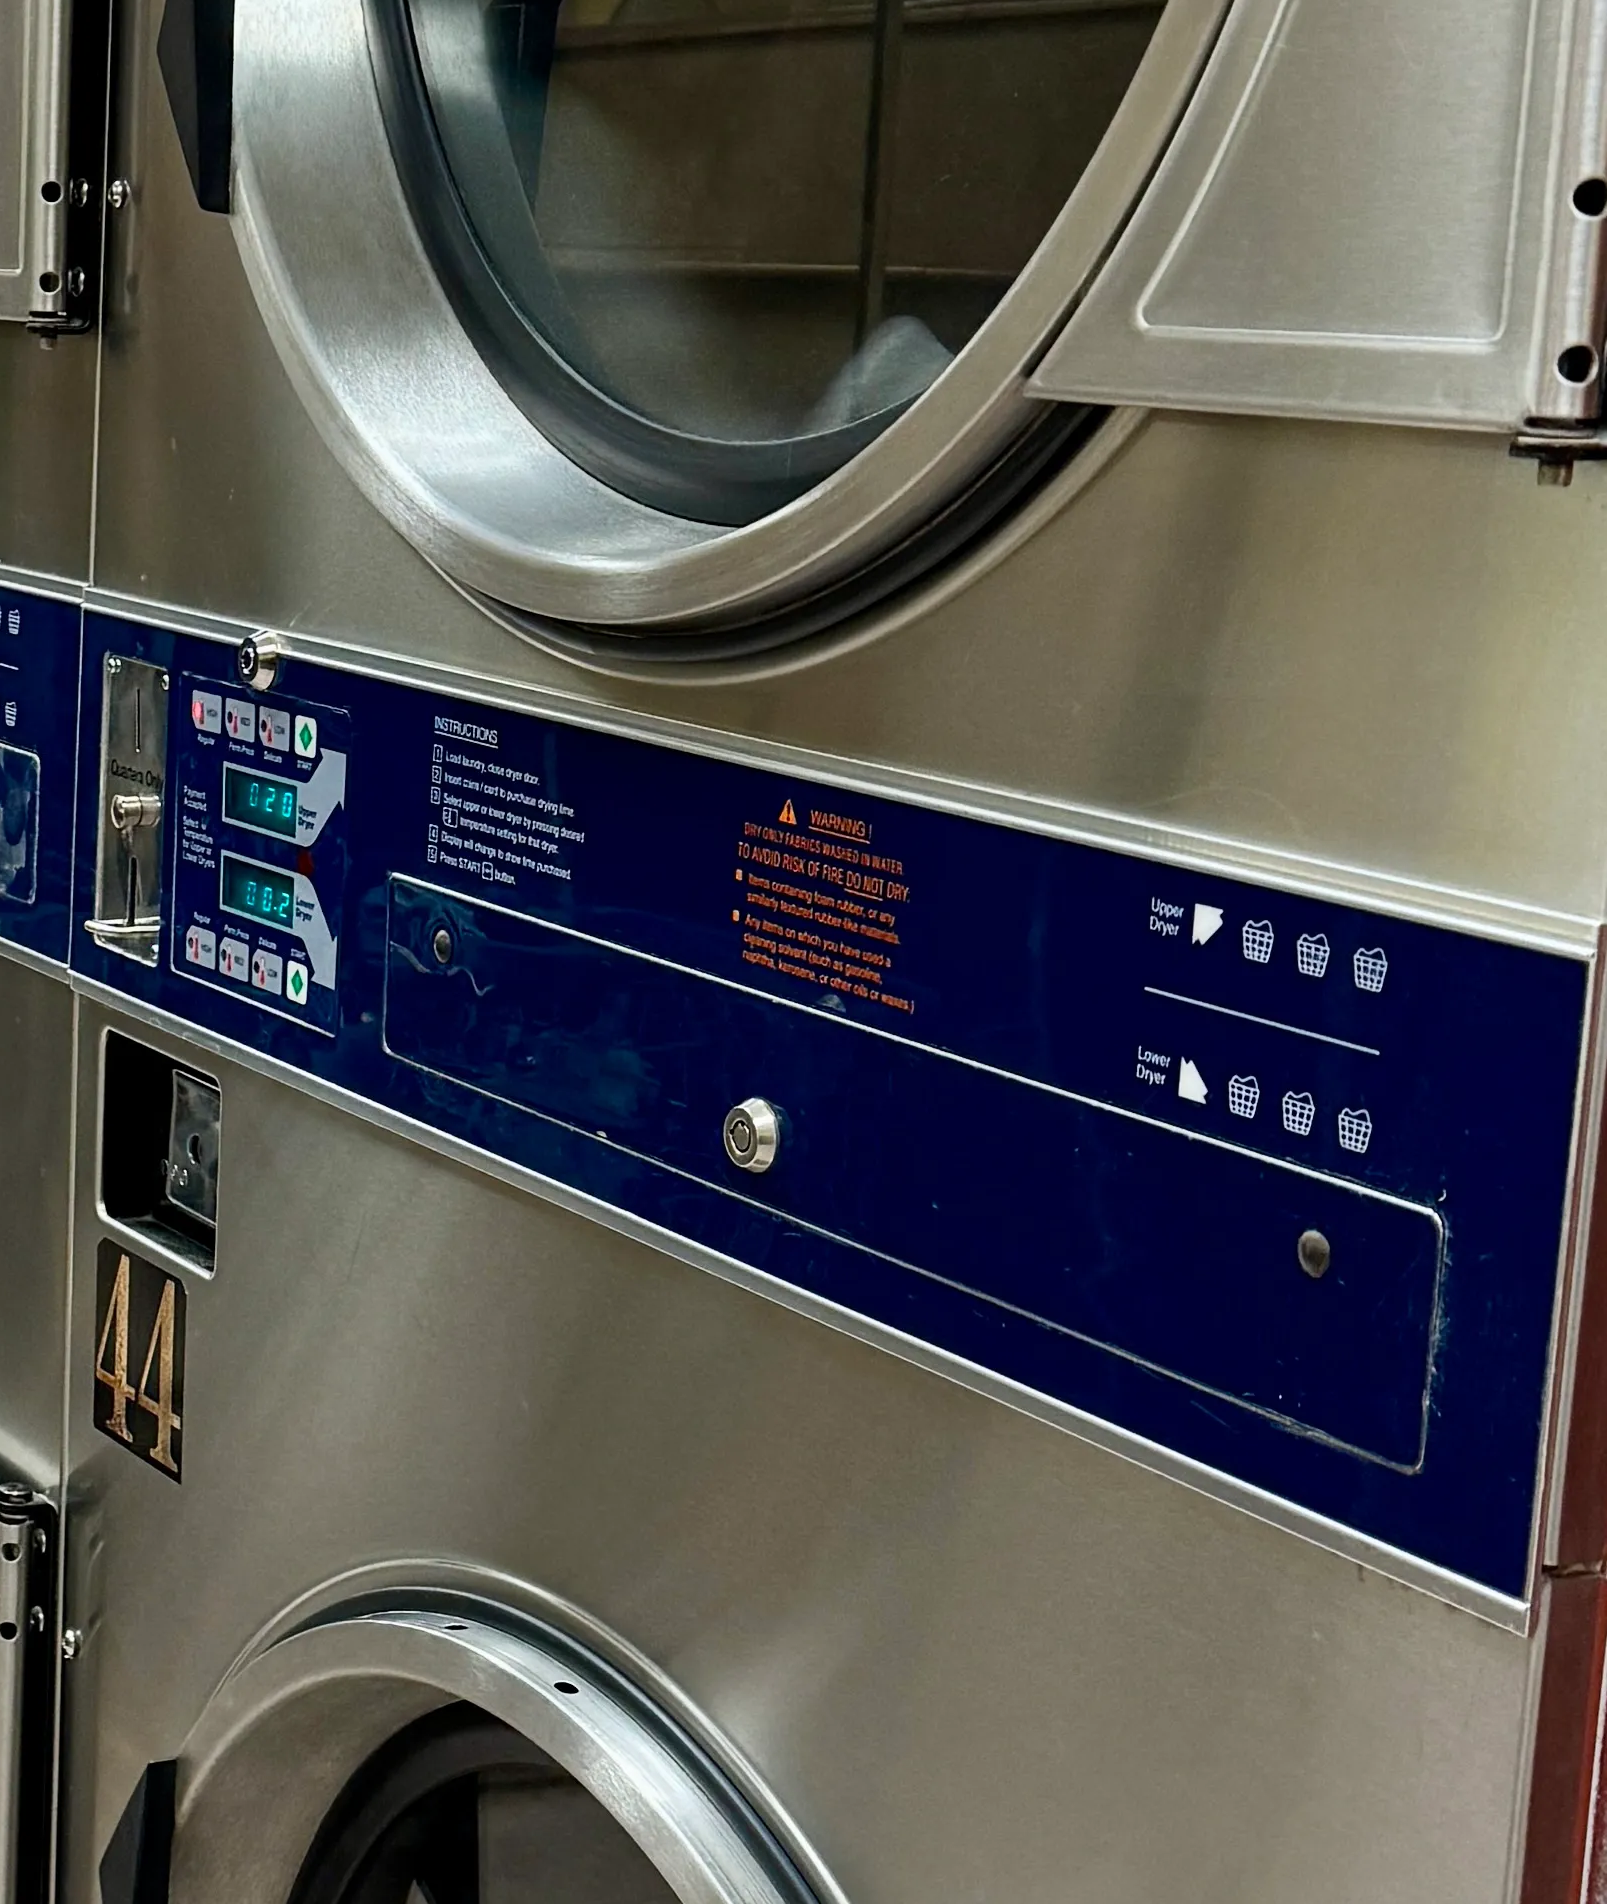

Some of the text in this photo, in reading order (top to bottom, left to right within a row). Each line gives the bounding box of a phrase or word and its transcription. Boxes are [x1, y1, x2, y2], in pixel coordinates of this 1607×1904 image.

[434, 716, 498, 744] INSTRUCTIONS
[446, 750, 461, 764] Load
[249, 782, 293, 818] 020
[443, 792, 462, 807] Select
[538, 798, 558, 815] drying
[441, 830, 463, 849] Display
[496, 828, 517, 845] setting
[744, 821, 762, 839] DRY
[762, 827, 784, 844] ONLY
[785, 832, 821, 854] FABRICS
[822, 842, 859, 864] WASHED
[861, 852, 870, 867] IN
[459, 857, 480, 873] START
[738, 842, 750, 859] TO
[752, 846, 781, 868] AVOID
[782, 853, 805, 874] RISK
[808, 861, 820, 877] OF
[822, 864, 844, 885] FIRE
[846, 871, 861, 890] DO
[863, 876, 884, 896] NOT
[771, 881, 813, 905] containing
[868, 909, 877, 919] or
[879, 912, 896, 927] any
[1151, 896, 1184, 919] Upper
[1149, 915, 1180, 937] Dryer
[745, 913, 761, 931] Any
[785, 927, 796, 938] on
[797, 931, 822, 946] which
[823, 939, 838, 952] you
[840, 943, 861, 959] have
[862, 950, 884, 966] used
[819, 974, 829, 984] or
[830, 976, 852, 992] other
[1138, 1045, 1171, 1068] Lower
[1136, 1063, 1166, 1086] Dryer
[96, 1253, 181, 1473] 44
